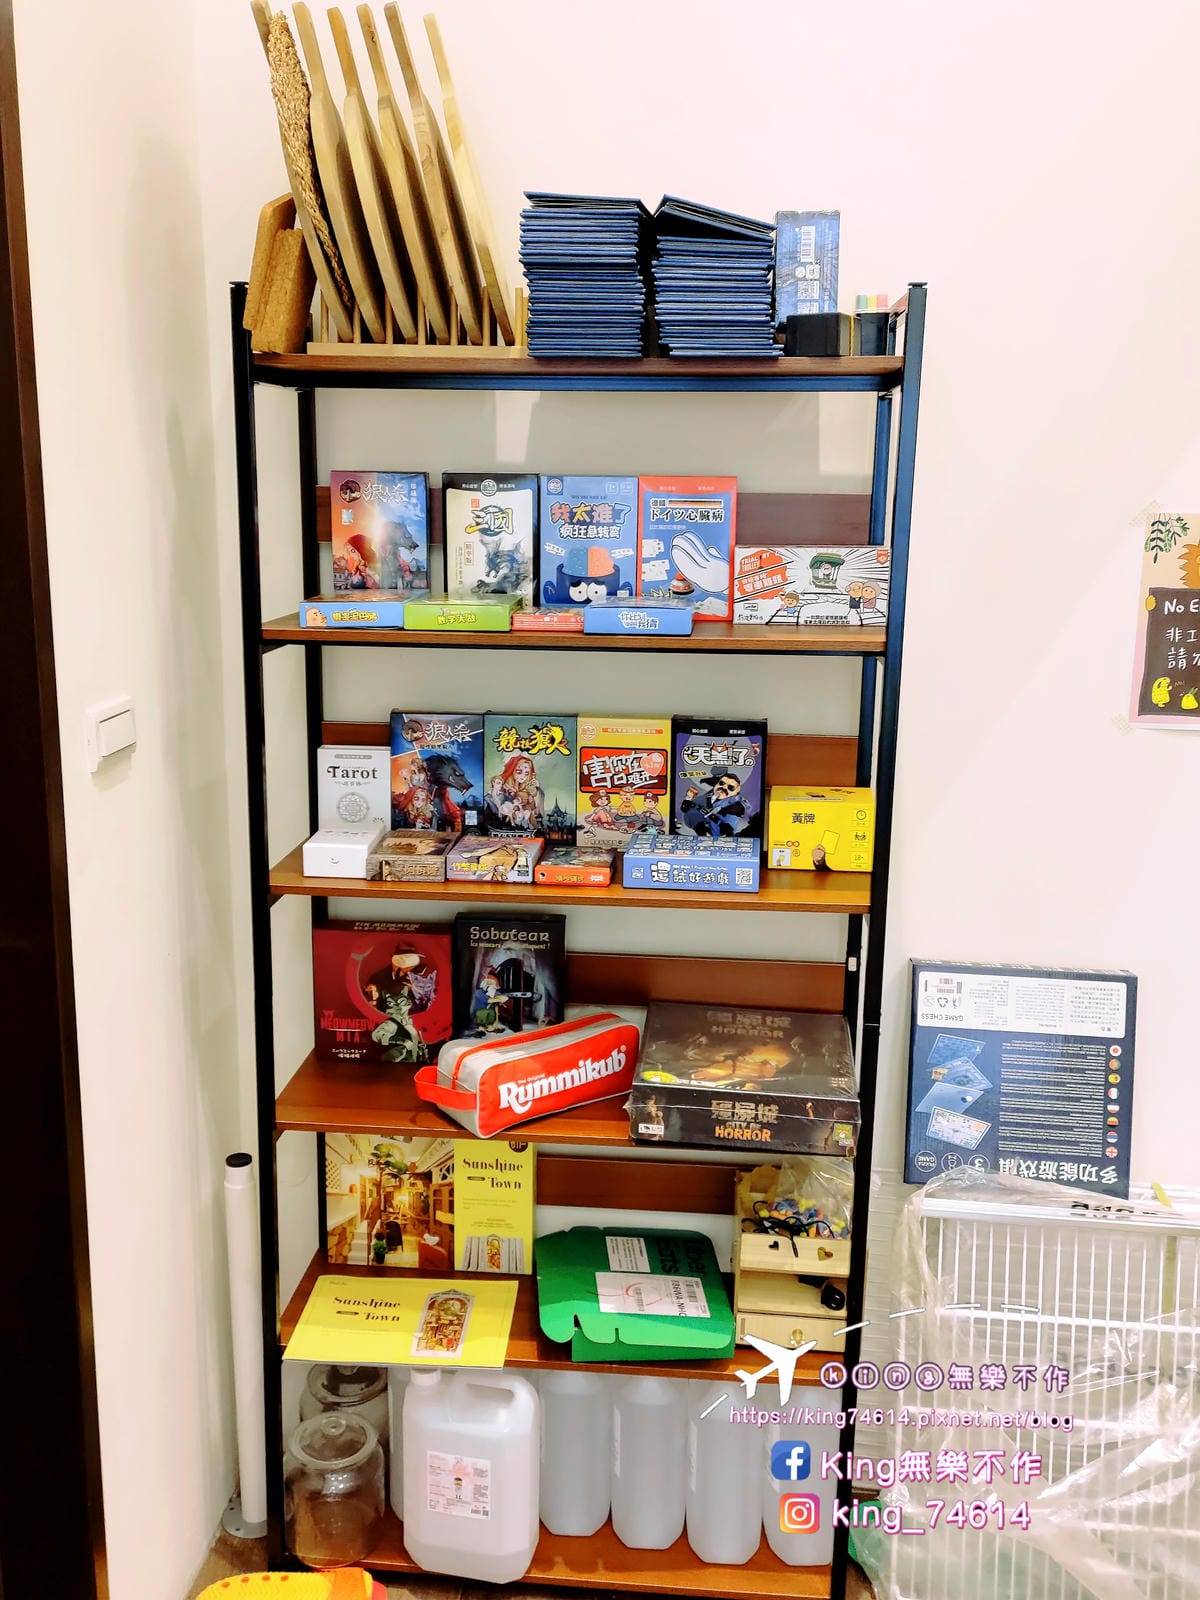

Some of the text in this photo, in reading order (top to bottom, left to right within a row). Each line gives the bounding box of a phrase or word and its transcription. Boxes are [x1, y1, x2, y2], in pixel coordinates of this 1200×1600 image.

[1164, 599, 1185, 615] No
[326, 765, 378, 779] Tarot
[921, 1012, 964, 1022] GAME CHESS
[498, 1048, 627, 1114] Rummikub
[714, 1125, 772, 1142] HORROR
[463, 1158, 523, 1173] Sunshine
[488, 1176, 521, 1190] Town
[333, 1296, 400, 1308] Sunshine
